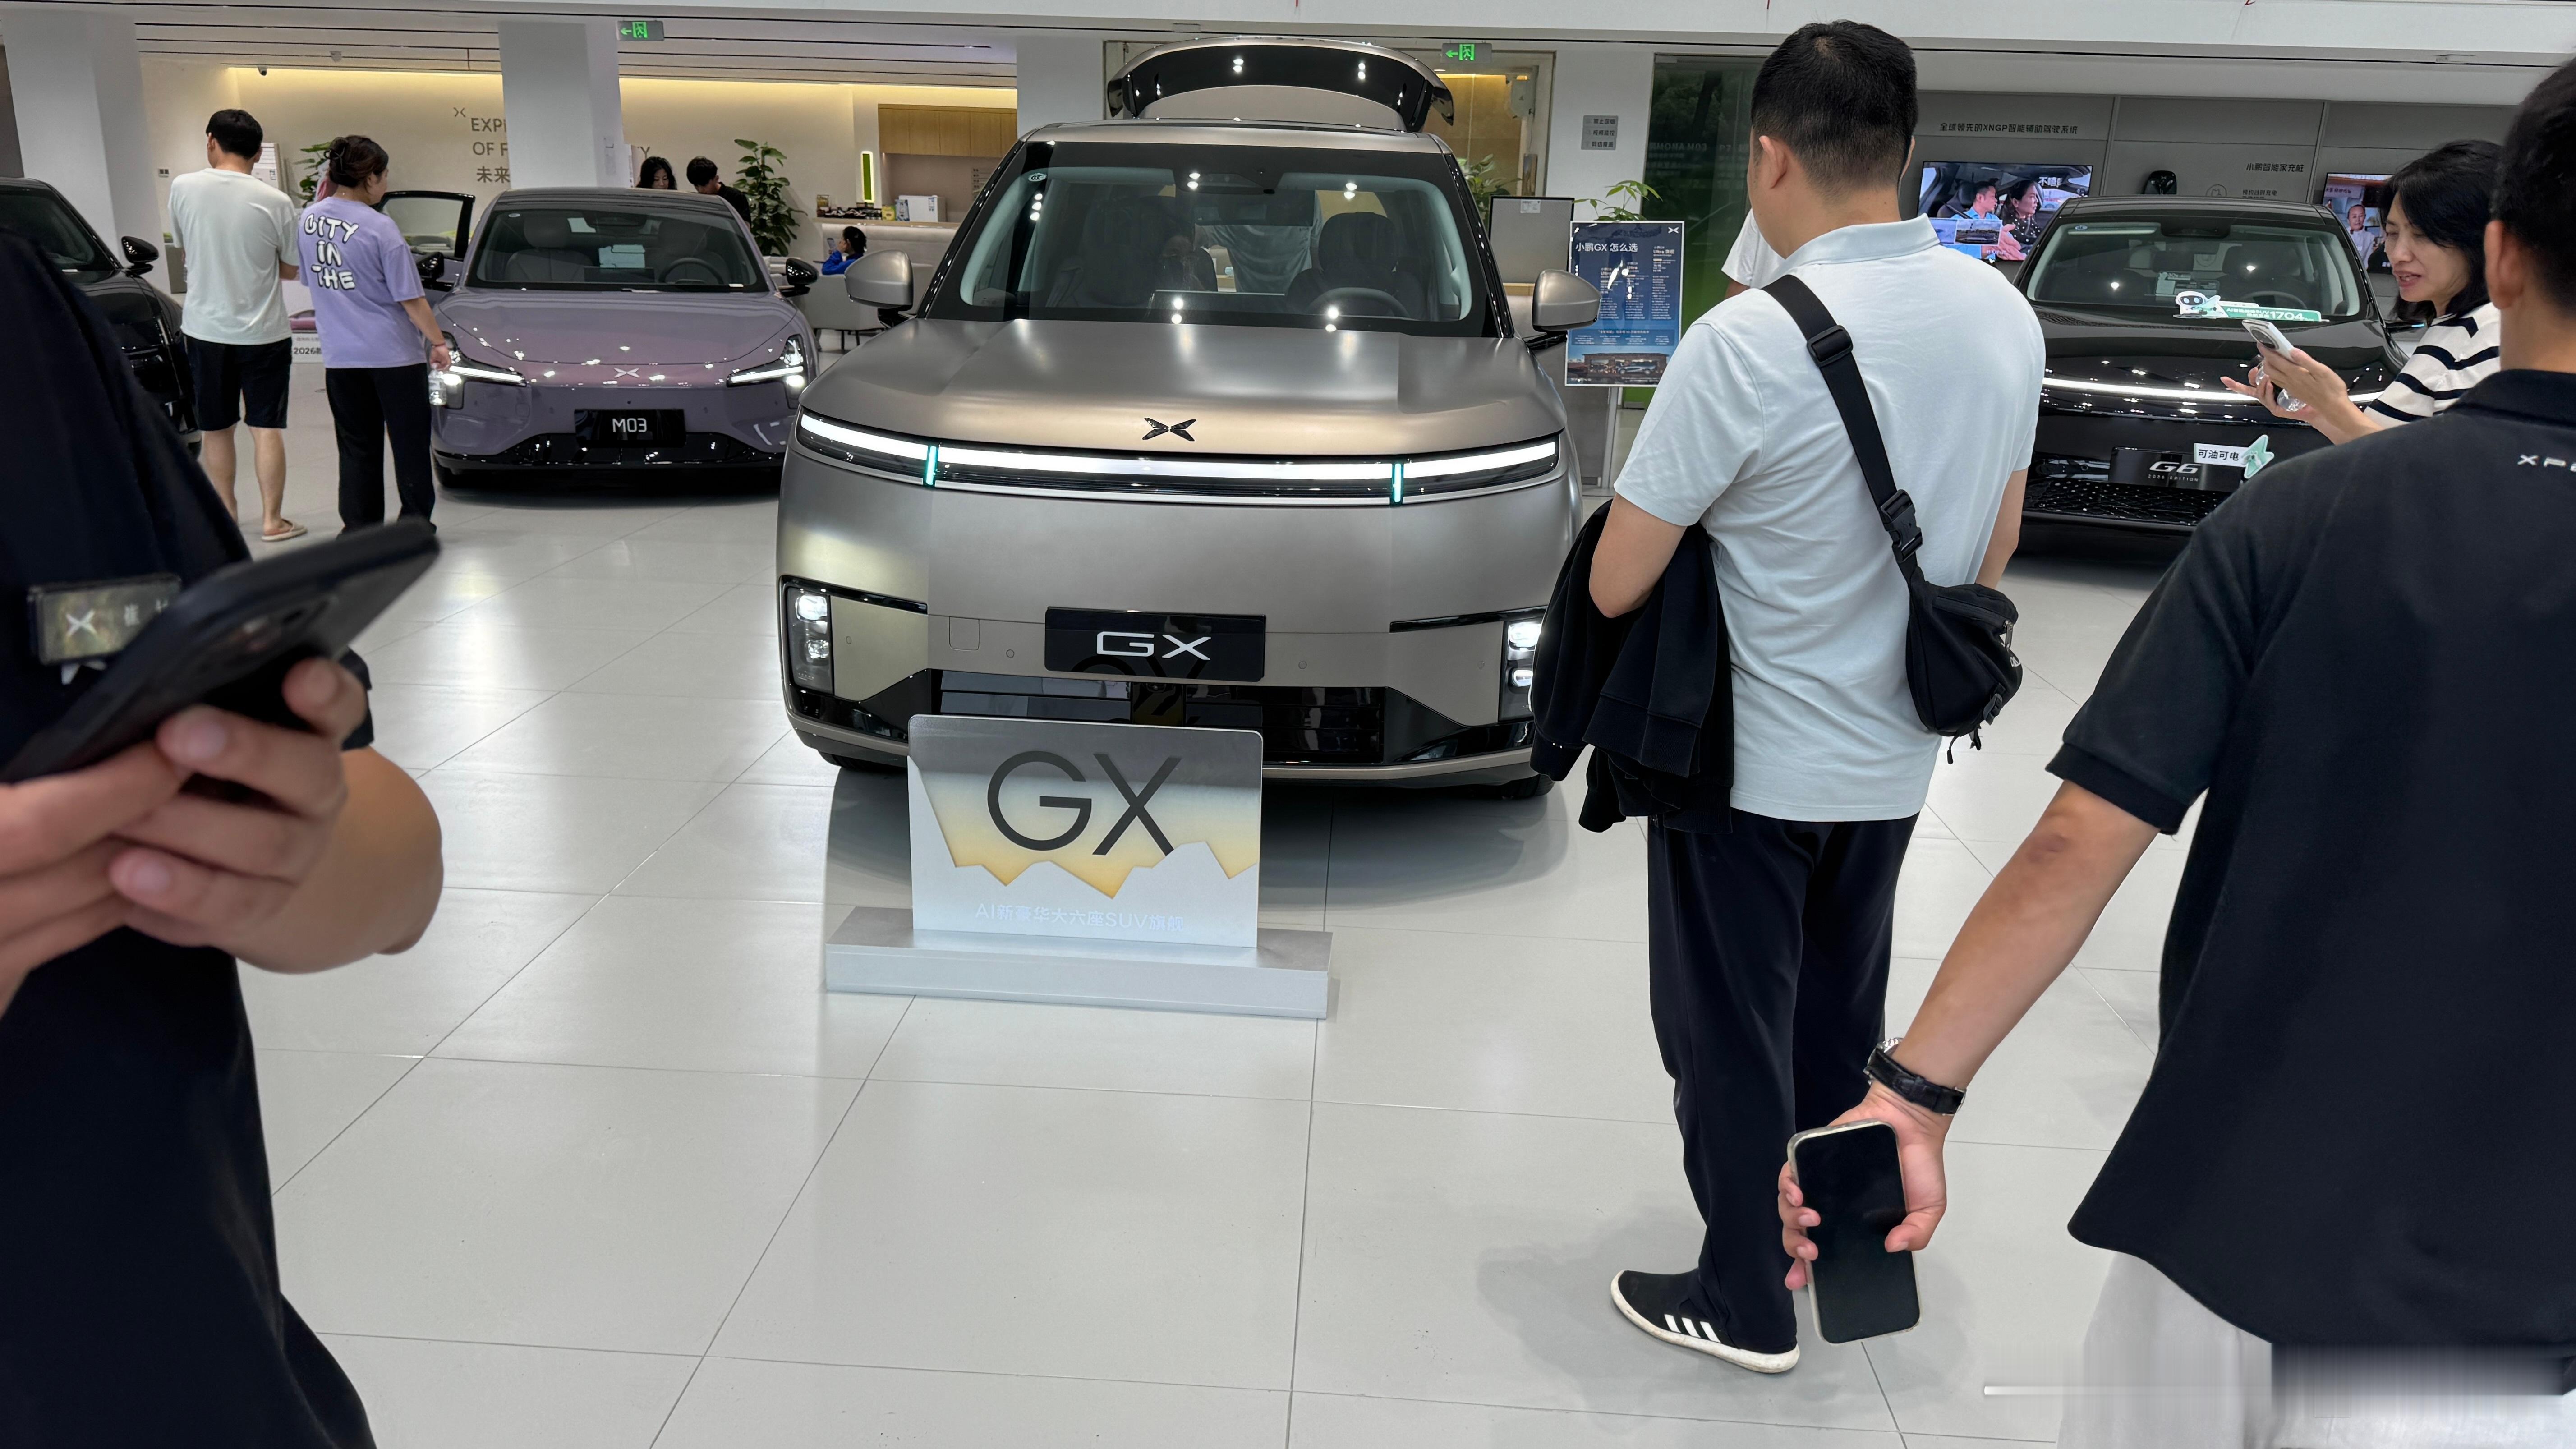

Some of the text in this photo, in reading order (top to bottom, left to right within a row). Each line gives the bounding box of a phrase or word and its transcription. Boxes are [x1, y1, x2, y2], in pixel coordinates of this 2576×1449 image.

[471, 118, 506, 132] EXP
[473, 142, 494, 155] OF
[477, 166, 511, 183] 未来
[2246, 163, 2304, 172] 小鹏智能家充桩
[1575, 243, 1638, 252] 小鹏GX 怎么选
[311, 264, 355, 290] THE
[612, 418, 647, 433] M03
[2198, 449, 2239, 461] 可油可电
[2149, 461, 2201, 474] G6
[2517, 454, 2576, 472] XP
[1096, 631, 1211, 660] GX
[987, 750, 1182, 856] GX
[975, 903, 1184, 932] AI新豪华大六座SUV旗舰
